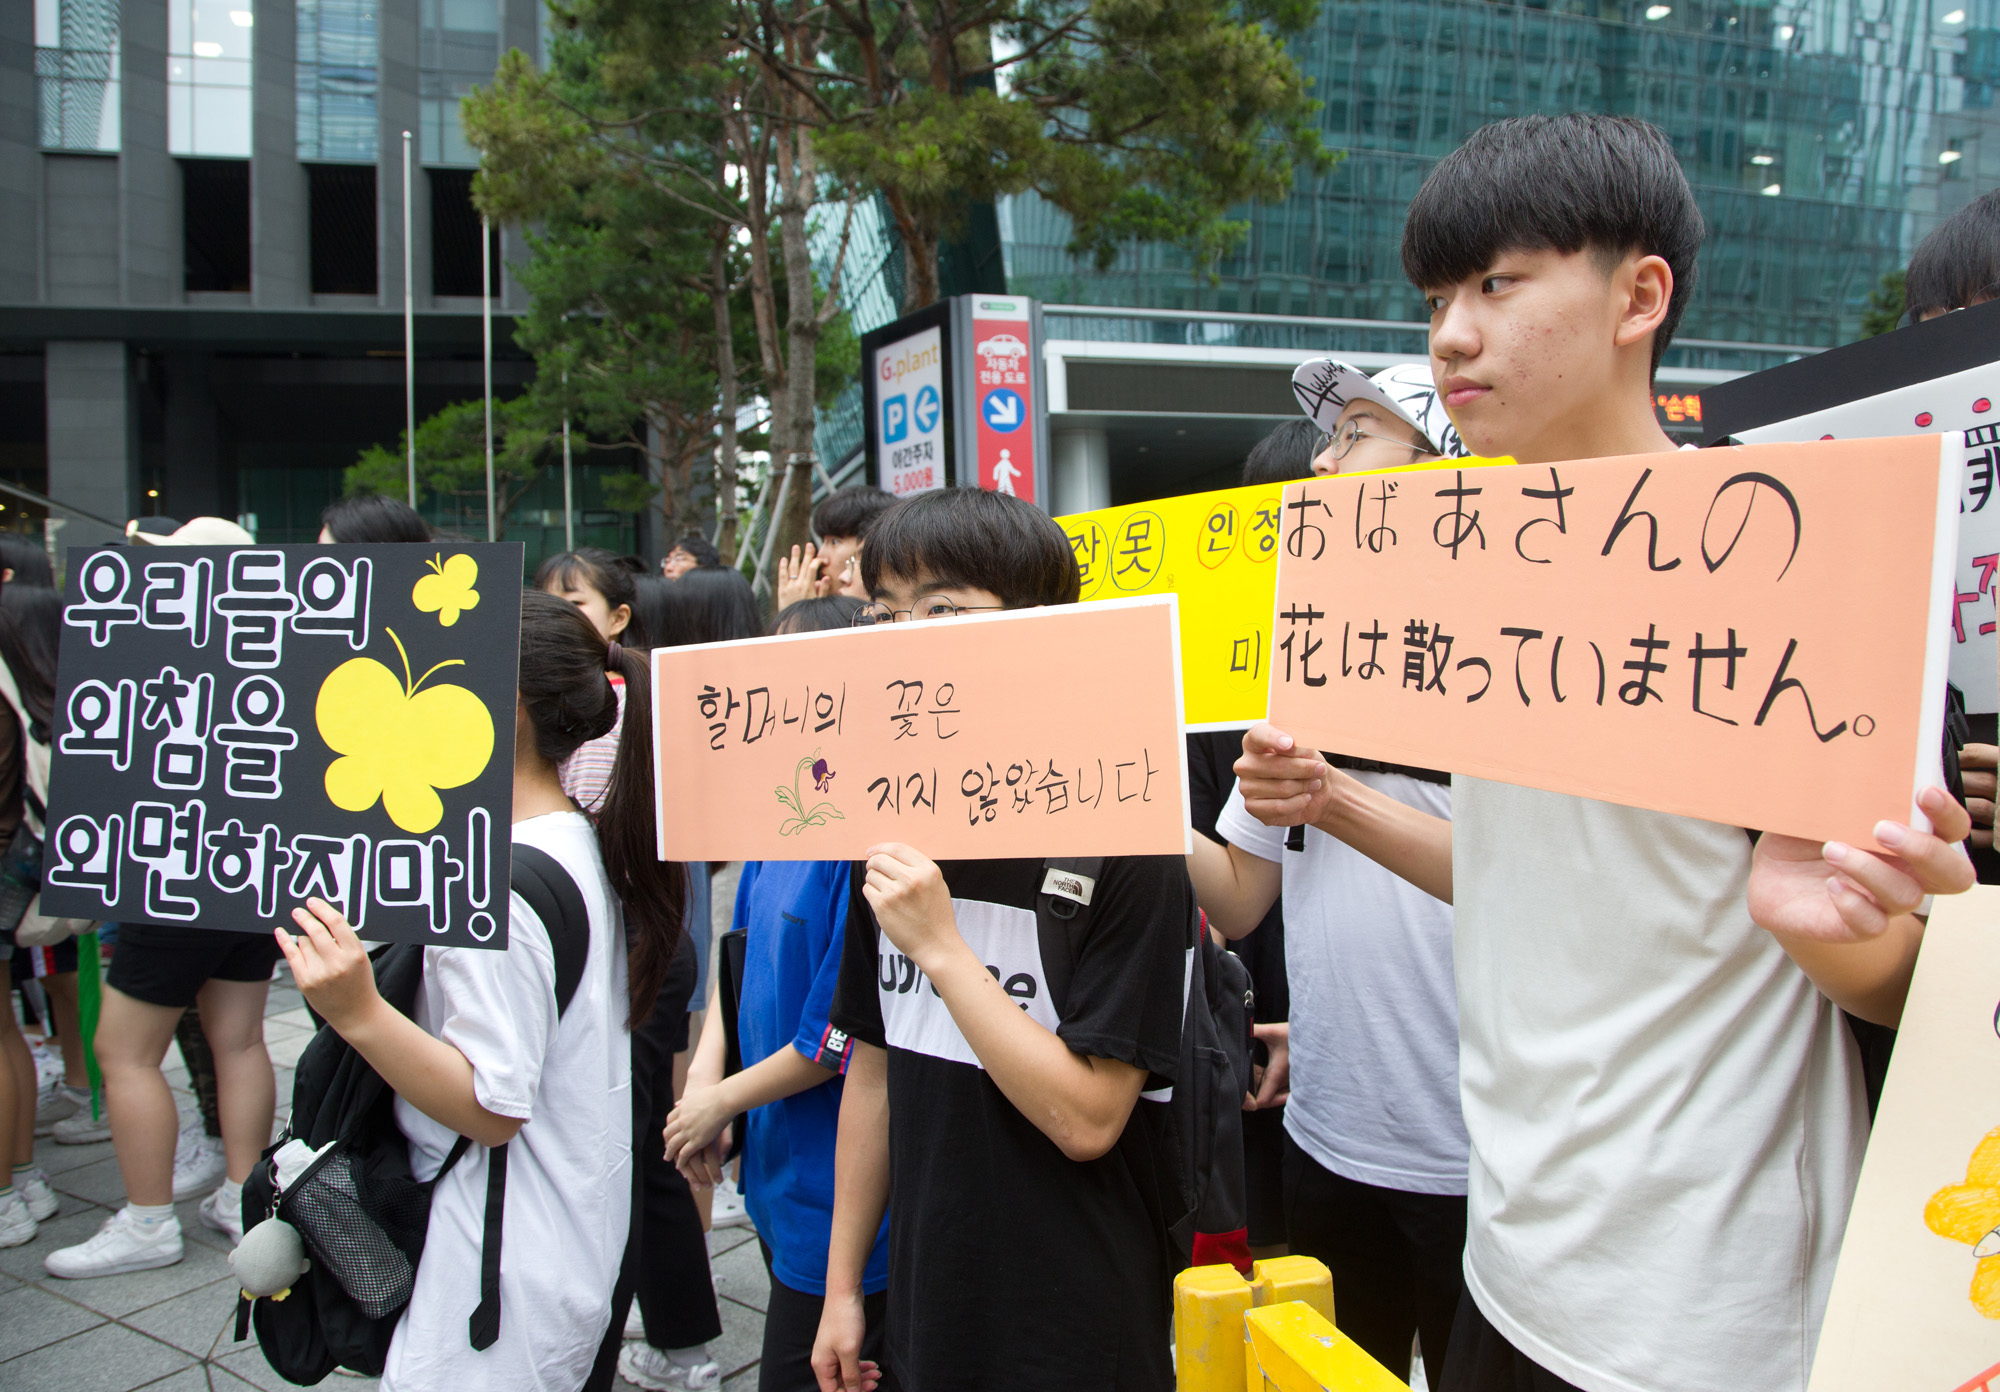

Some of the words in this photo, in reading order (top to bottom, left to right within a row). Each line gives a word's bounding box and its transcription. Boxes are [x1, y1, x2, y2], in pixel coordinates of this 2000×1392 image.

[880, 342, 938, 384] G.plant
[1004, 371, 1027, 385] 도로
[888, 403, 903, 436] P
[1286, 467, 1802, 582] おばあさんの
[64, 550, 372, 669] 우리들의
[697, 681, 845, 750] 할머니의
[886, 679, 961, 742] 꽃은
[1279, 602, 1877, 743] 花は散っていません。
[59, 666, 298, 799] 외침을
[867, 766, 937, 815] 지지
[961, 748, 1160, 826] 않았습니다
[48, 799, 497, 942] 외면하지마!
